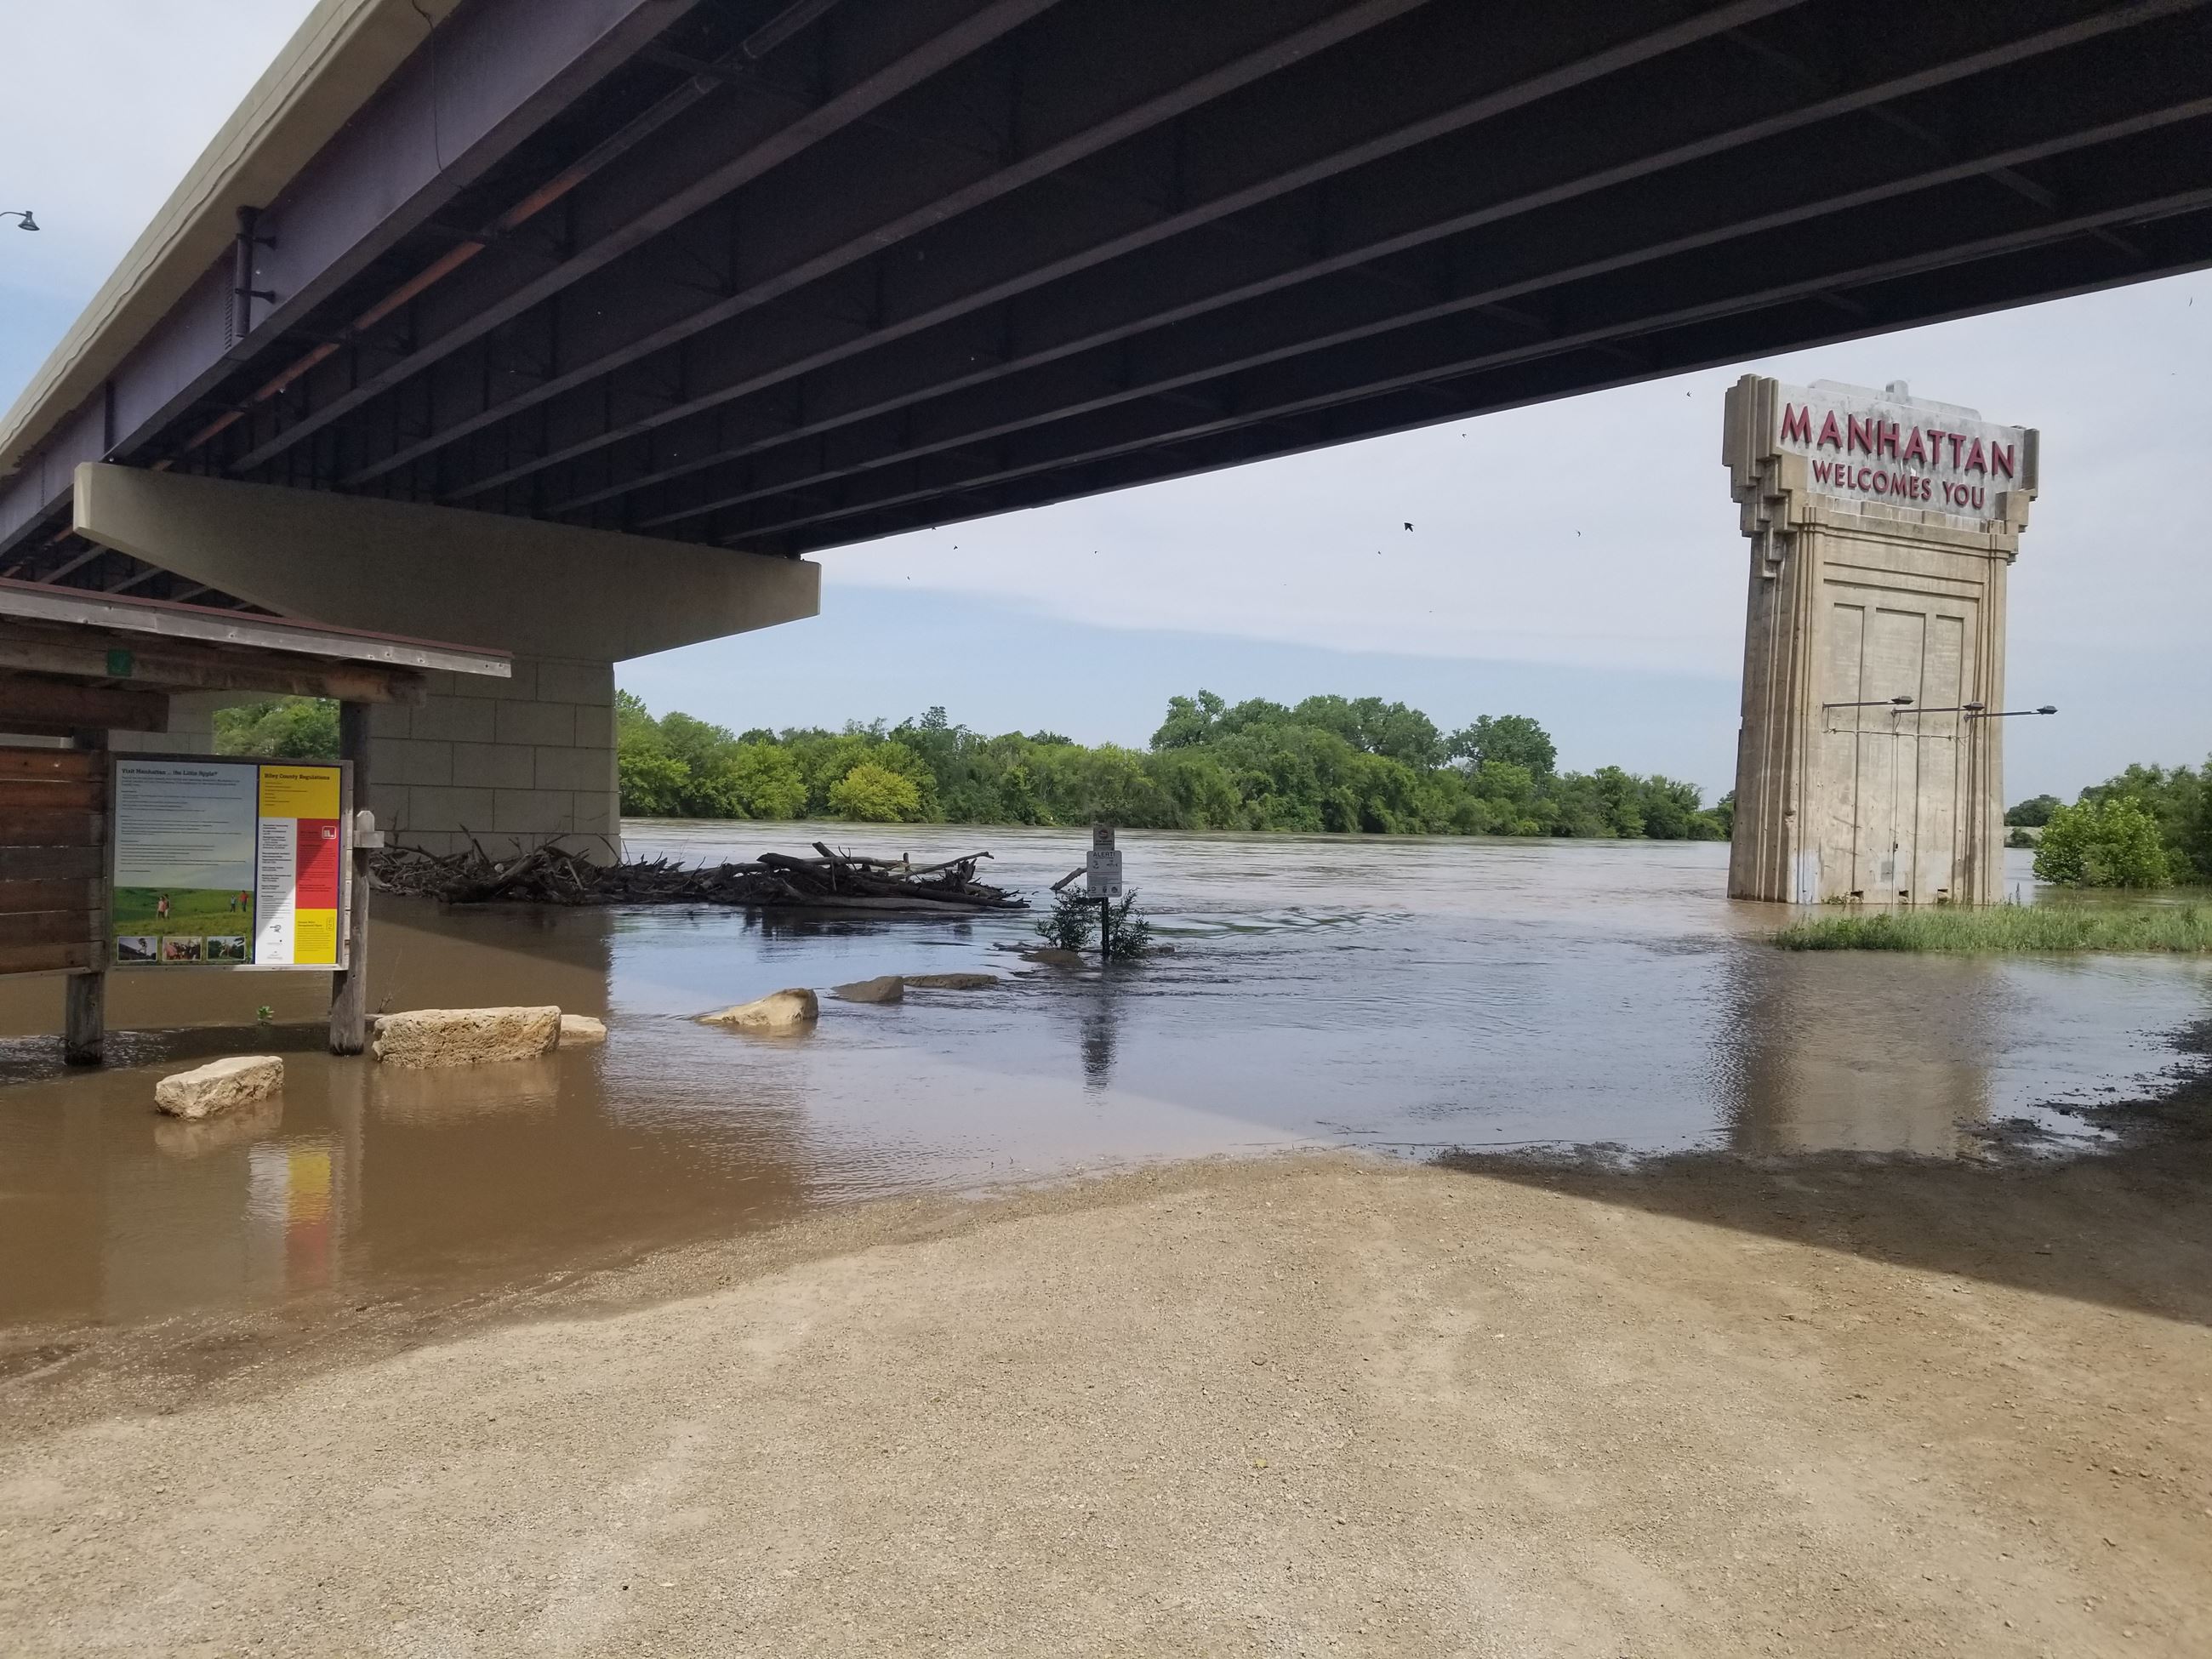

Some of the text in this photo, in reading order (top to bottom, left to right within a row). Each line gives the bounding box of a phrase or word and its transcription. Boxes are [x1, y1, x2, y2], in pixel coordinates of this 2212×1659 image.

[1781, 402, 2015, 478] MANHATTAN
[1812, 459, 1985, 509] WELCOMES YOU
